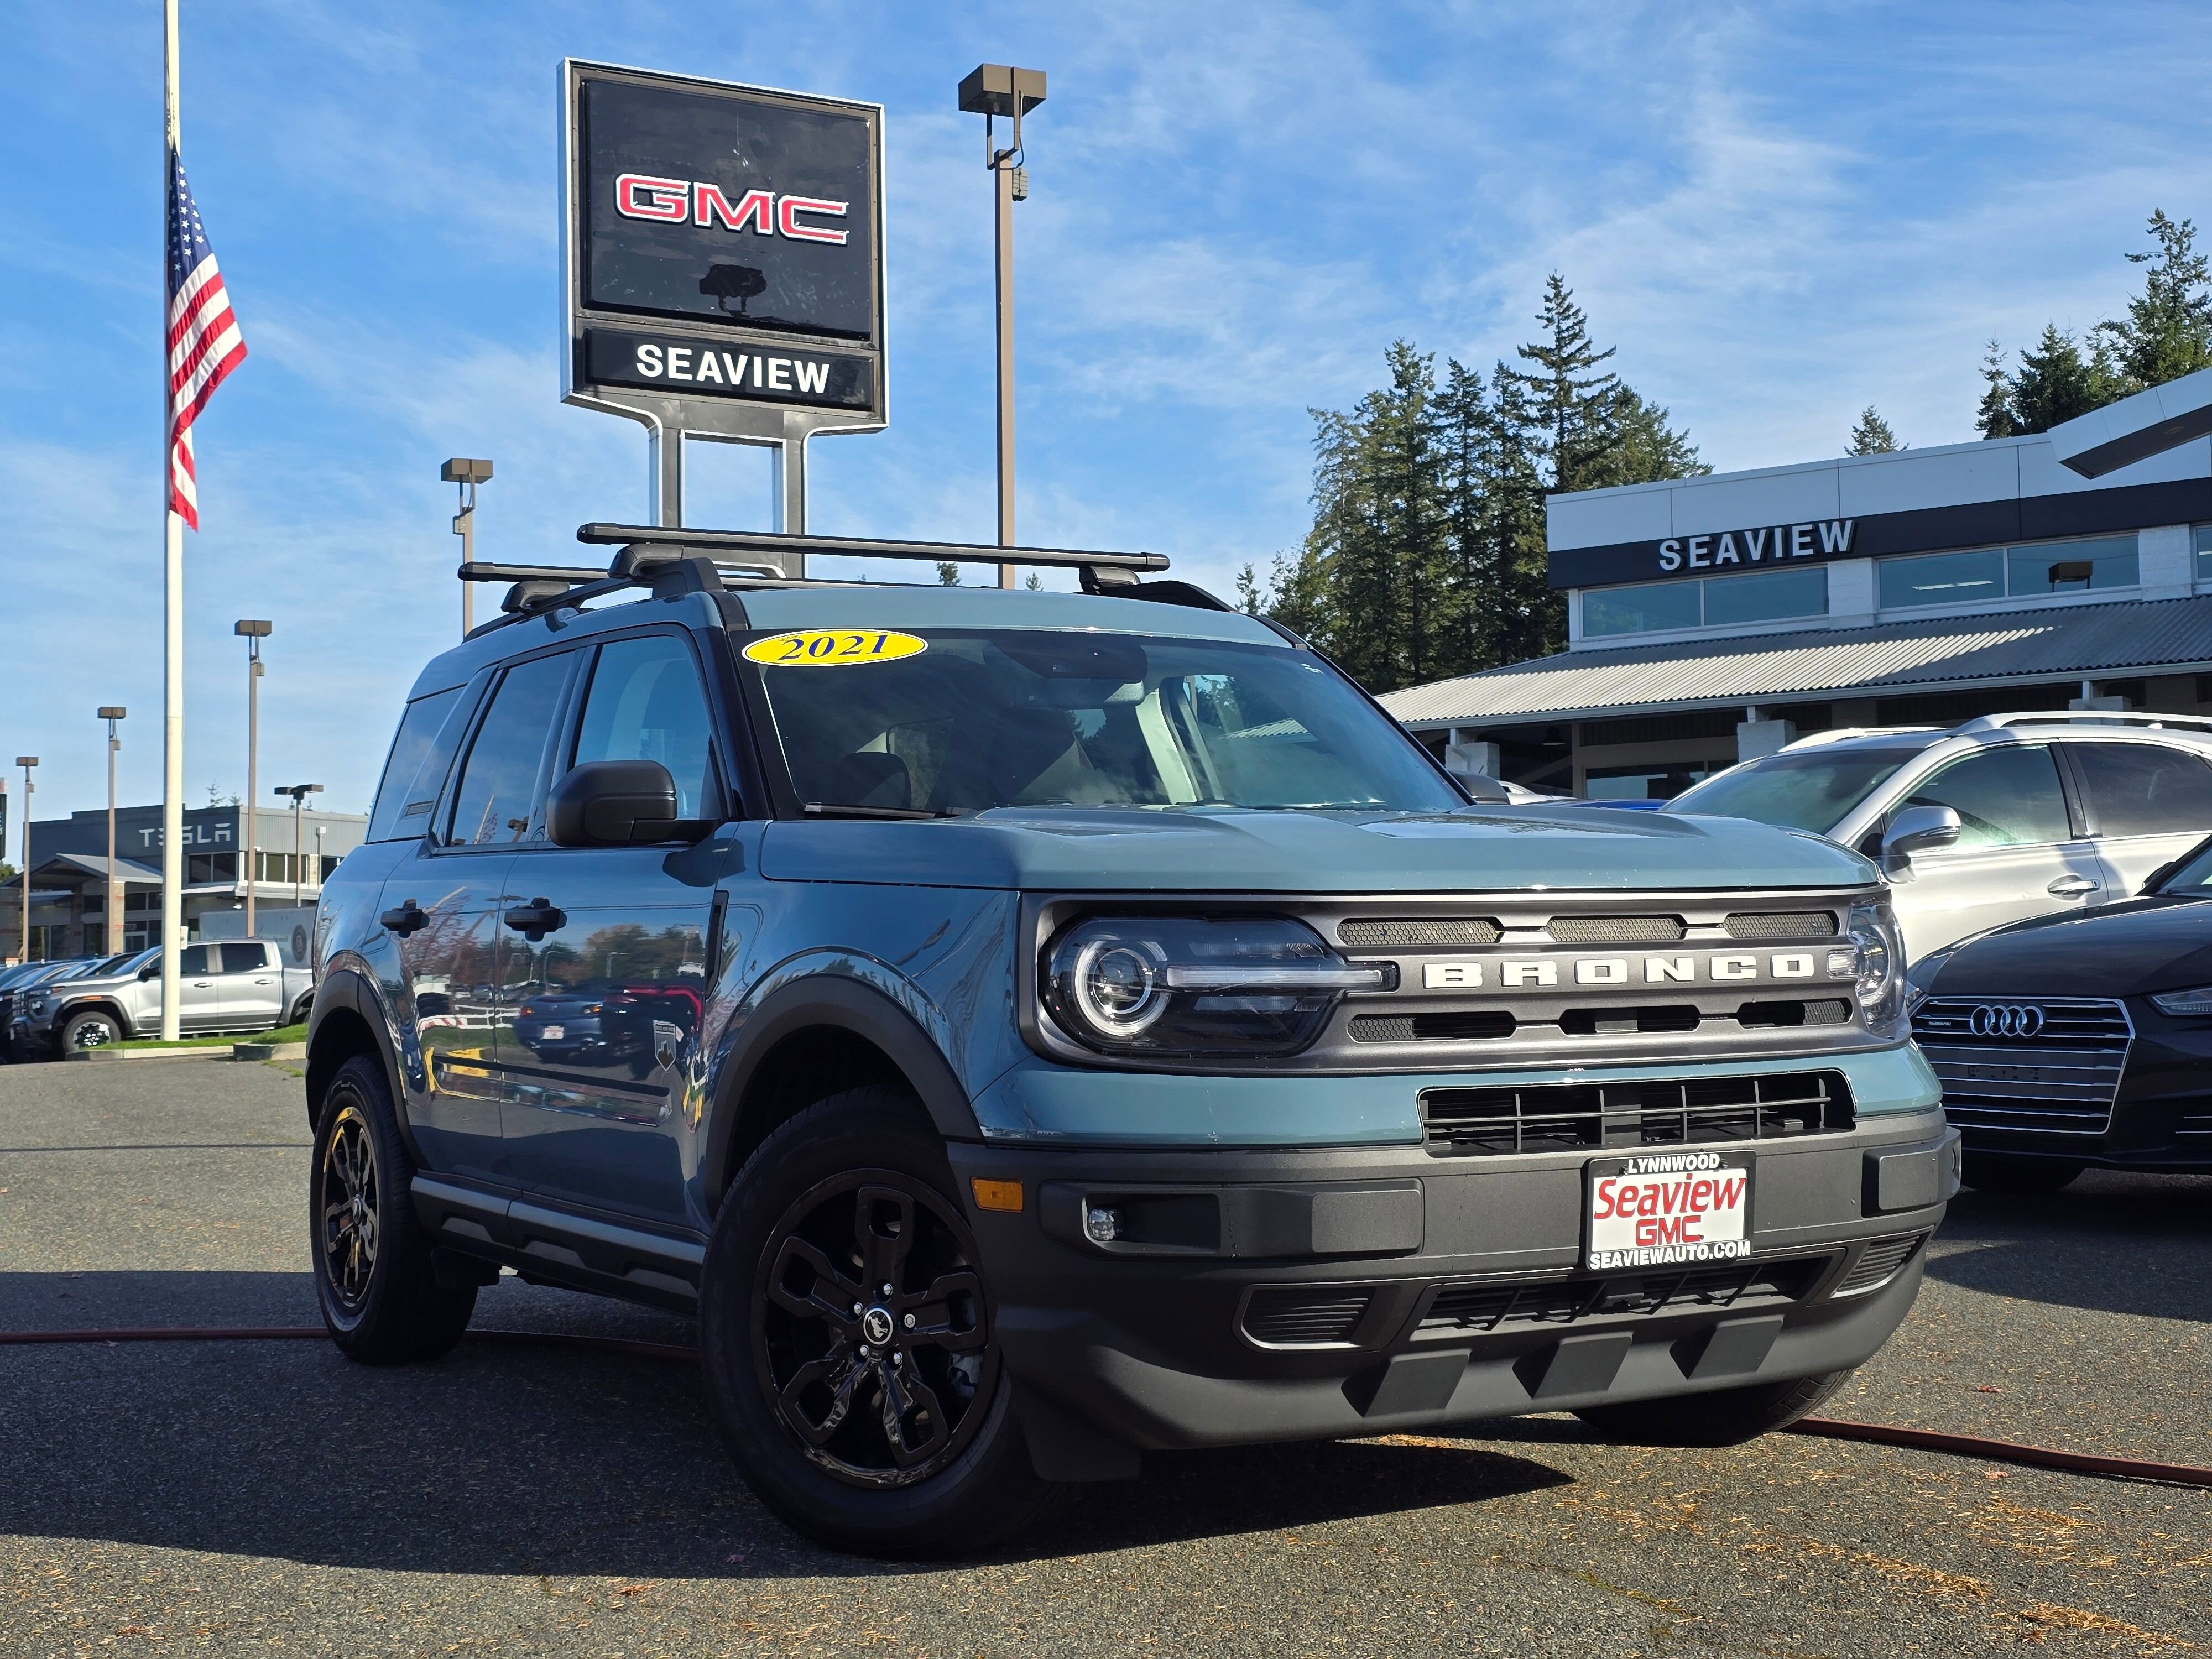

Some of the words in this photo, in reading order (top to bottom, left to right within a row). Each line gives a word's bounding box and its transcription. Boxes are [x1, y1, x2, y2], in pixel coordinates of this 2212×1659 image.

[615, 173, 849, 245] GMC
[637, 344, 830, 394] SEAVIEW
[1659, 520, 1854, 571] SEAVIEW
[776, 634, 888, 661] 2021
[1422, 953, 1814, 989] BRONCO
[1628, 1154, 1720, 1174] LYNNWOOD
[1594, 1173, 1746, 1220] Seaview
[1635, 1214, 1702, 1246] GMC
[1590, 1240, 1751, 1270] SEAVIEWAUTO.COM
